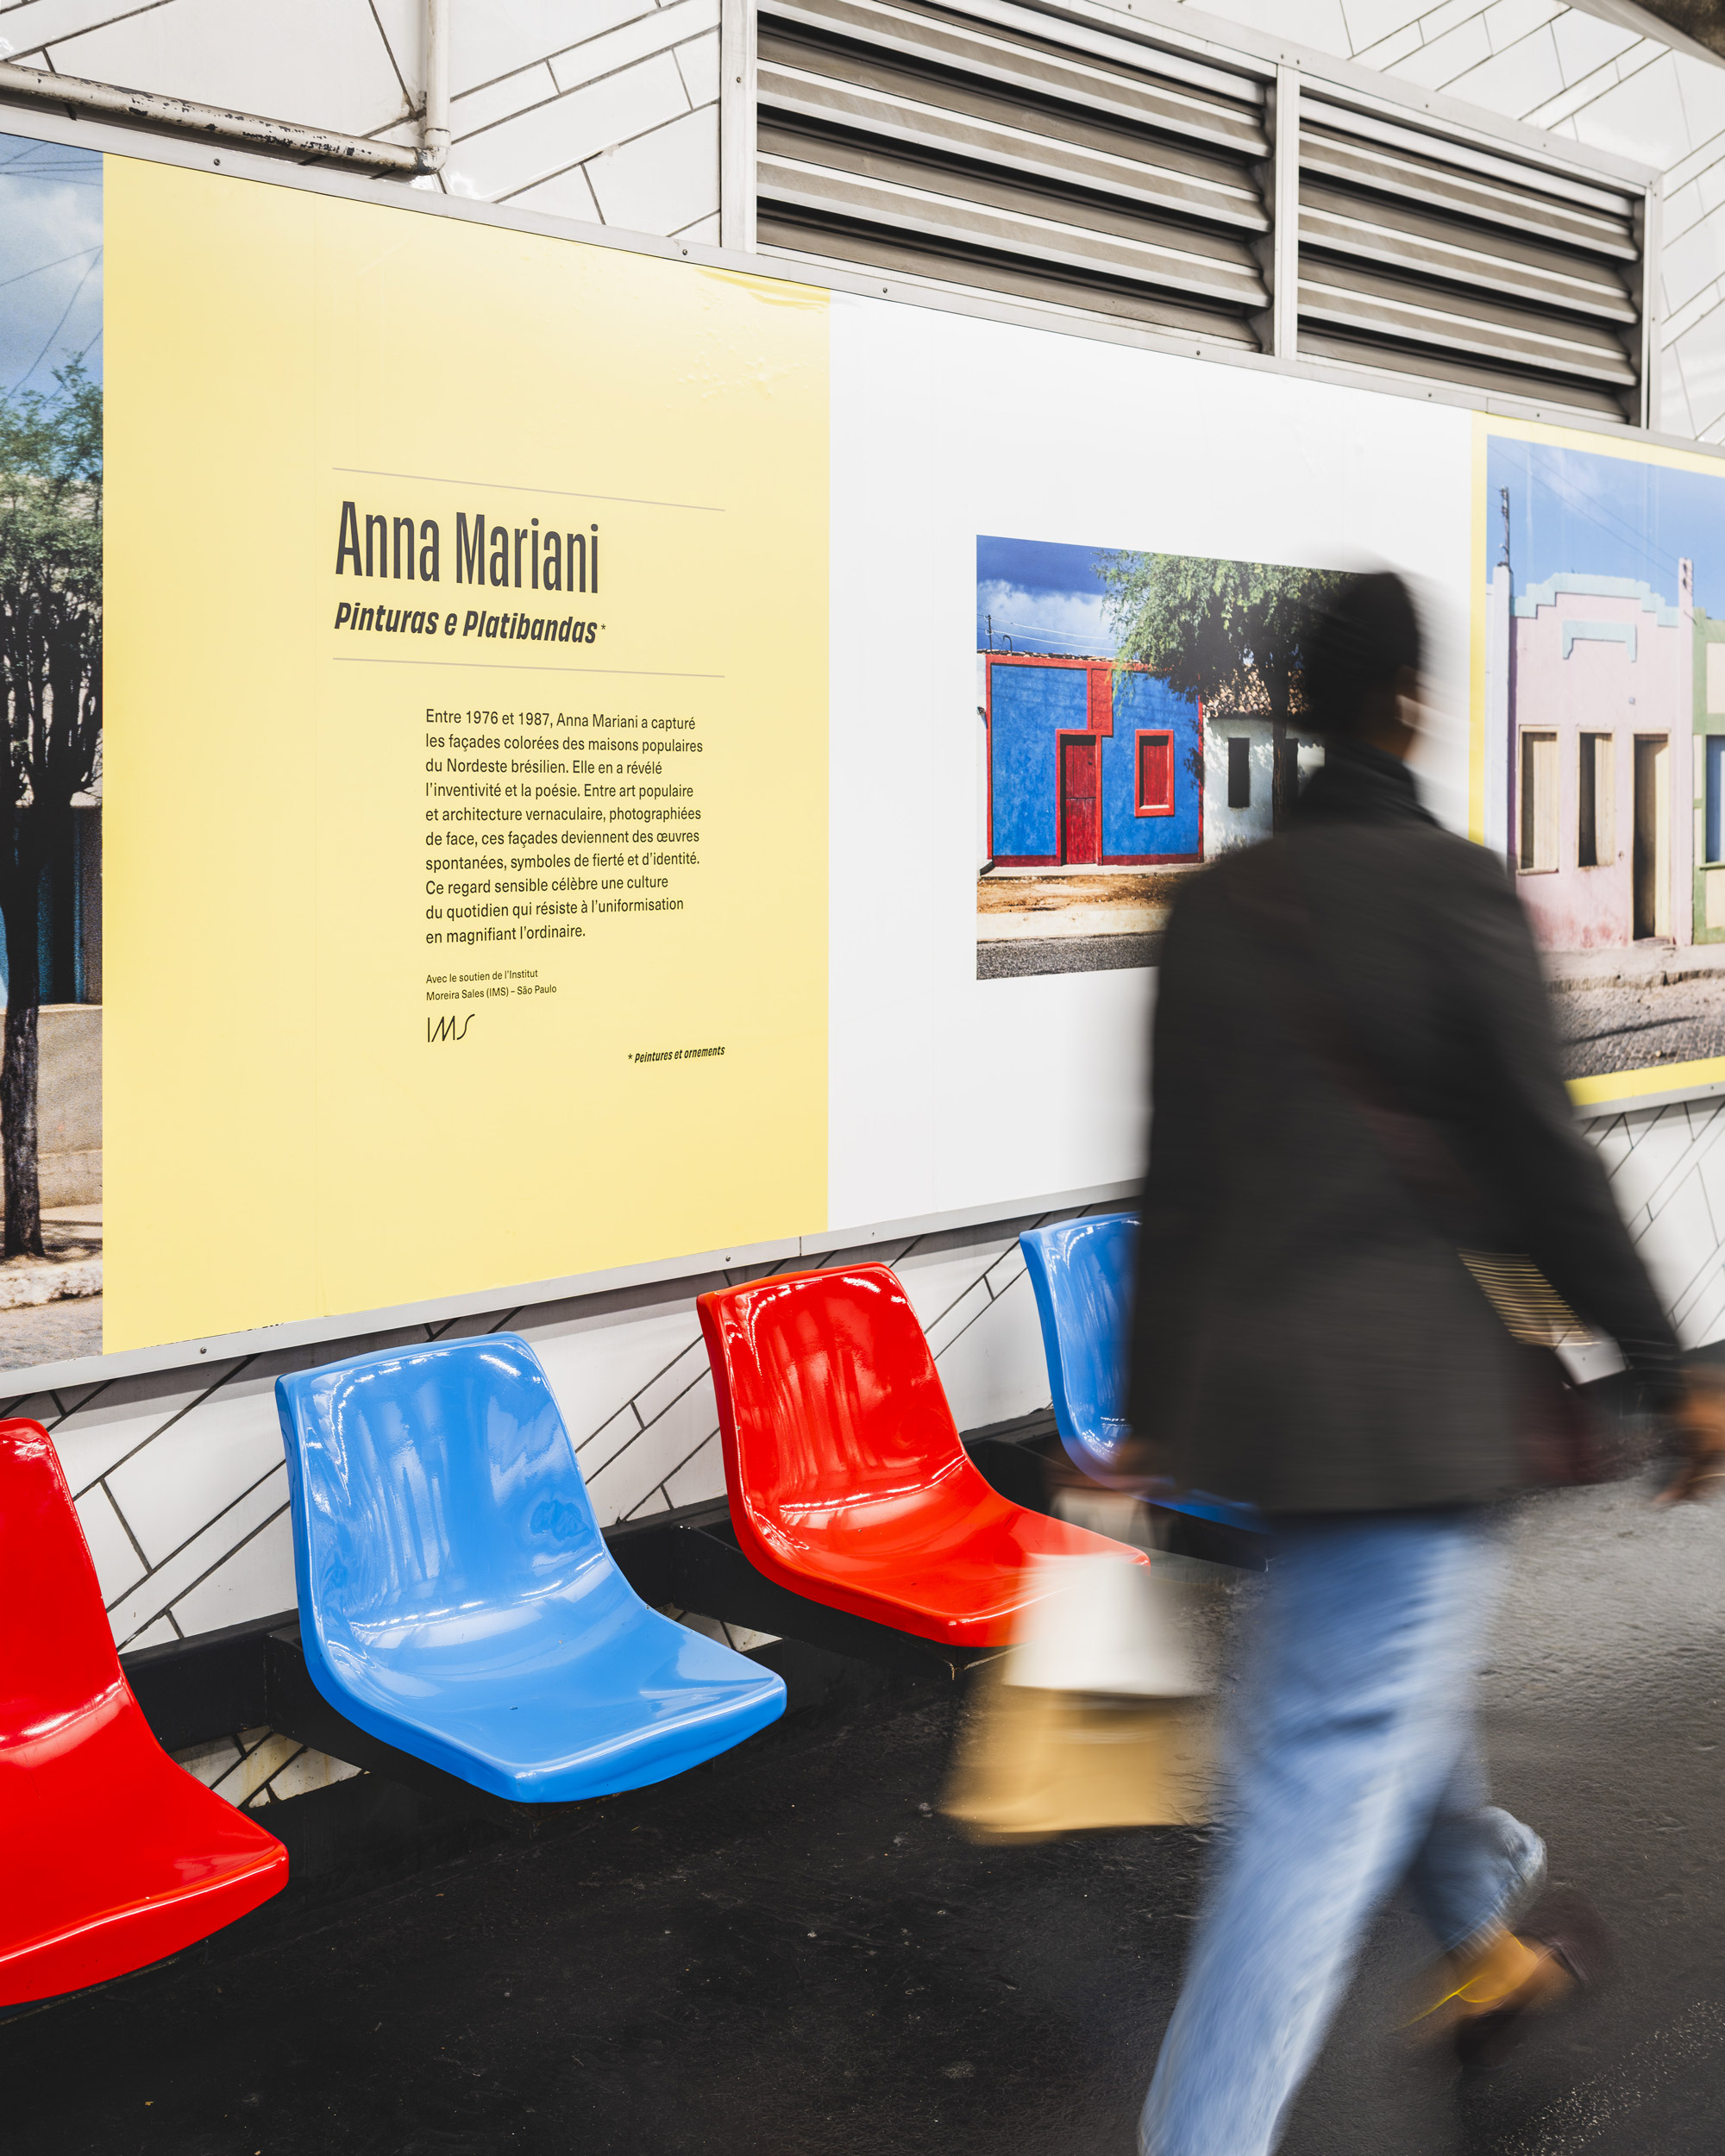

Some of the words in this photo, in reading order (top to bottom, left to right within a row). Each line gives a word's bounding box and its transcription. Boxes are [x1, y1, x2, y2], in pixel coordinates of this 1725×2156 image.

[335, 500, 441, 583] Anna
[455, 511, 599, 594] Mariani
[333, 601, 440, 636] Pinturas
[443, 612, 458, 636] e
[426, 708, 462, 724] Entre
[466, 710, 499, 725] 1976
[501, 712, 515, 725] et
[518, 711, 554, 729] 1987,
[555, 712, 589, 727] Anna
[593, 713, 638, 729] Mariani
[641, 718, 649, 729] a
[650, 716, 696, 732] capturé
[425, 732, 446, 749] les
[448, 733, 501, 753] façades
[504, 735, 560, 750] colorées
[561, 736, 586, 751] des
[588, 736, 639, 752] maisons
[642, 738, 704, 755] populaires
[425, 757, 442, 773] du
[447, 757, 508, 774] Nordeste
[511, 758, 569, 774] brésilien.
[573, 759, 595, 774] Elle
[598, 763, 613, 774] en
[616, 763, 624, 774] a
[626, 760, 662, 775] révélé
[425, 781, 502, 798] l’inventivité
[505, 784, 518, 798] et
[521, 782, 532, 798] la
[535, 783, 580, 800] poésie.
[584, 783, 617, 798] Entre
[618, 785, 637, 798] art
[638, 783, 694, 800] populaire
[425, 808, 439, 822] et
[442, 806, 523, 822] architecture
[525, 806, 606, 824] vernaculaire,
[609, 806, 702, 824] photographiées
[425, 830, 442, 846] de
[445, 830, 478, 849] face,
[481, 834, 505, 845] ces
[507, 830, 558, 849] façades
[561, 830, 630, 844] deviennent
[631, 829, 654, 843] des
[656, 831, 699, 843] œuvres
[425, 855, 507, 874] spontanées,
[510, 853, 571, 872] symboles
[574, 853, 590, 868] de
[592, 852, 624, 867] fierté
[627, 853, 639, 867] et
[642, 851, 700, 866] d’identité.
[425, 880, 444, 895] Ce
[448, 879, 491, 898] regard
[494, 877, 549, 893] sensible
[551, 876, 599, 892] célèbre
[601, 879, 624, 890] une
[626, 874, 668, 889] culture
[425, 905, 442, 920] du
[446, 903, 509, 922] quotidien
[511, 901, 532, 919] qui
[536, 900, 578, 916] résiste
[580, 899, 588, 914] à
[591, 897, 684, 913] l’uniformisation
[425, 932, 442, 944] en
[446, 926, 517, 946] magnifiant
[519, 924, 586, 940] l’ordinaire.
[425, 974, 448, 984] Avec
[448, 973, 457, 983] le
[458, 972, 491, 982] soutien
[492, 970, 503, 981] de
[504, 968, 538, 980] l’Institut
[426, 991, 460, 1001] Moreira
[461, 988, 485, 1000] Sales
[486, 986, 509, 999] (IMS)
[517, 986, 533, 995] São
[534, 984, 557, 994] Paulo
[427, 1013, 476, 1044] IMS
[634, 1050, 674, 1064] Peintures
[674, 1049, 683, 1060] et
[683, 1045, 725, 1059] ornements
